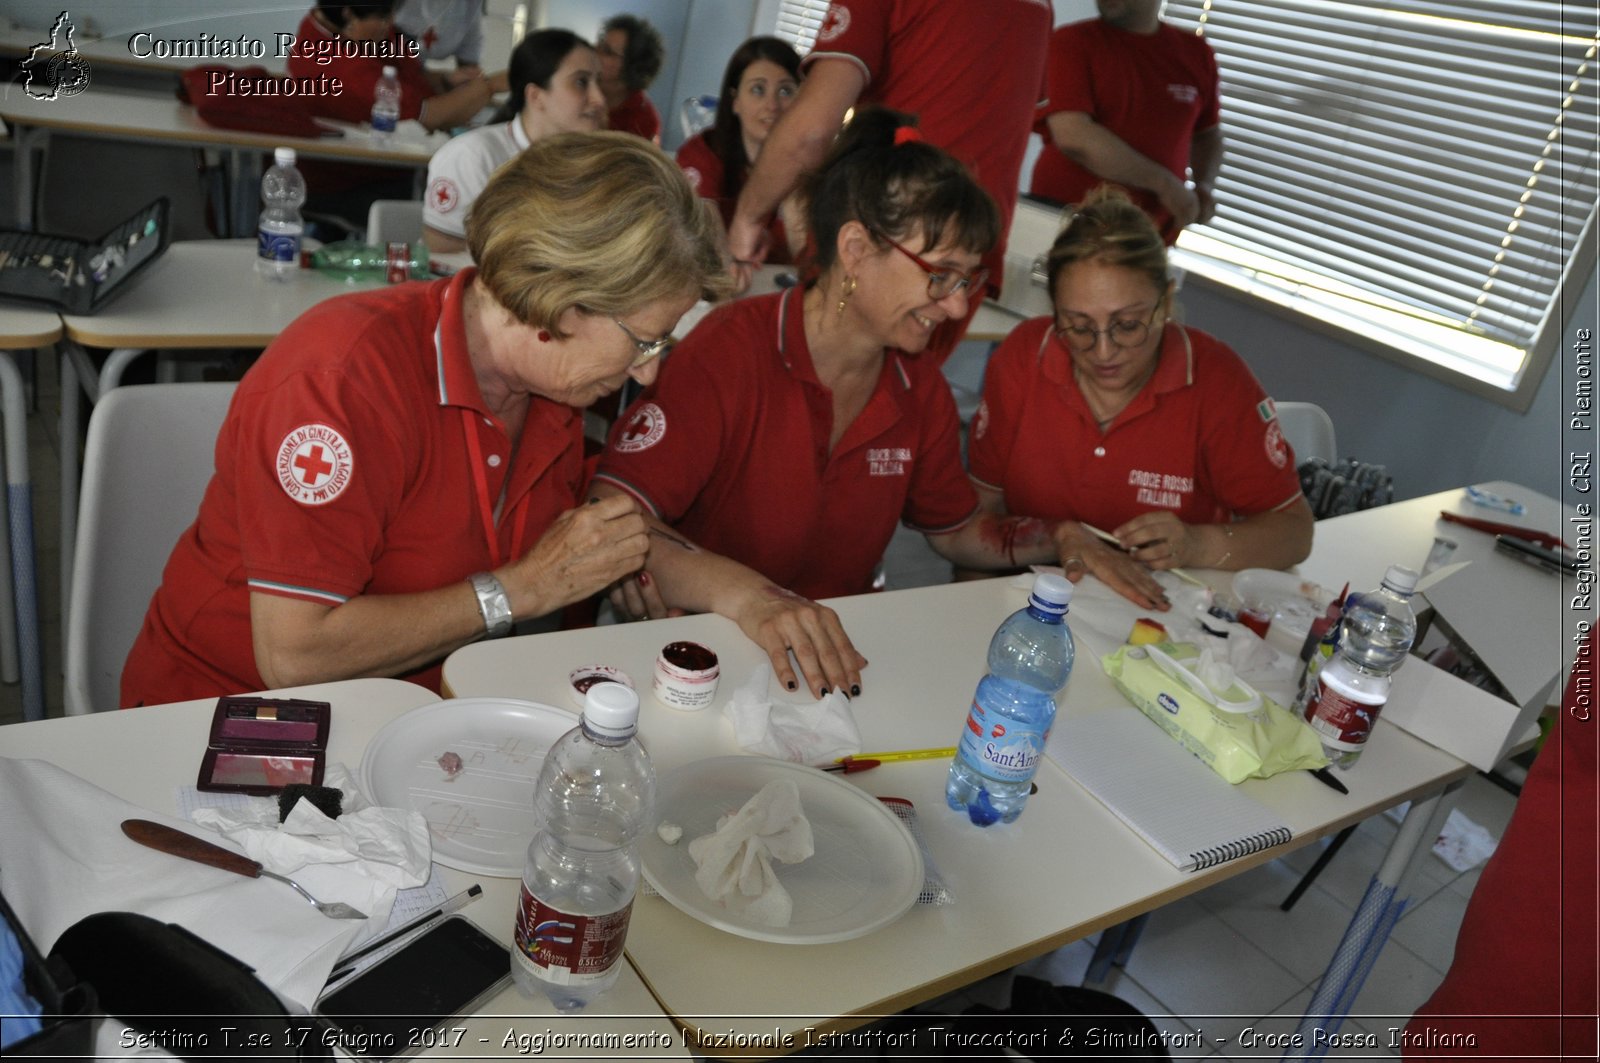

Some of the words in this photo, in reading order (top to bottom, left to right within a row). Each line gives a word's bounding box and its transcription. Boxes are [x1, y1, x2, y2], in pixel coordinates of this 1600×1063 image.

[297, 429, 307, 441] DI
[308, 427, 343, 450] GINEVRA
[327, 462, 350, 494] AGOSTO
[1128, 469, 1162, 489] CROCE
[1162, 474, 1194, 494] ROSSA
[1136, 488, 1182, 508] ITALIANA
